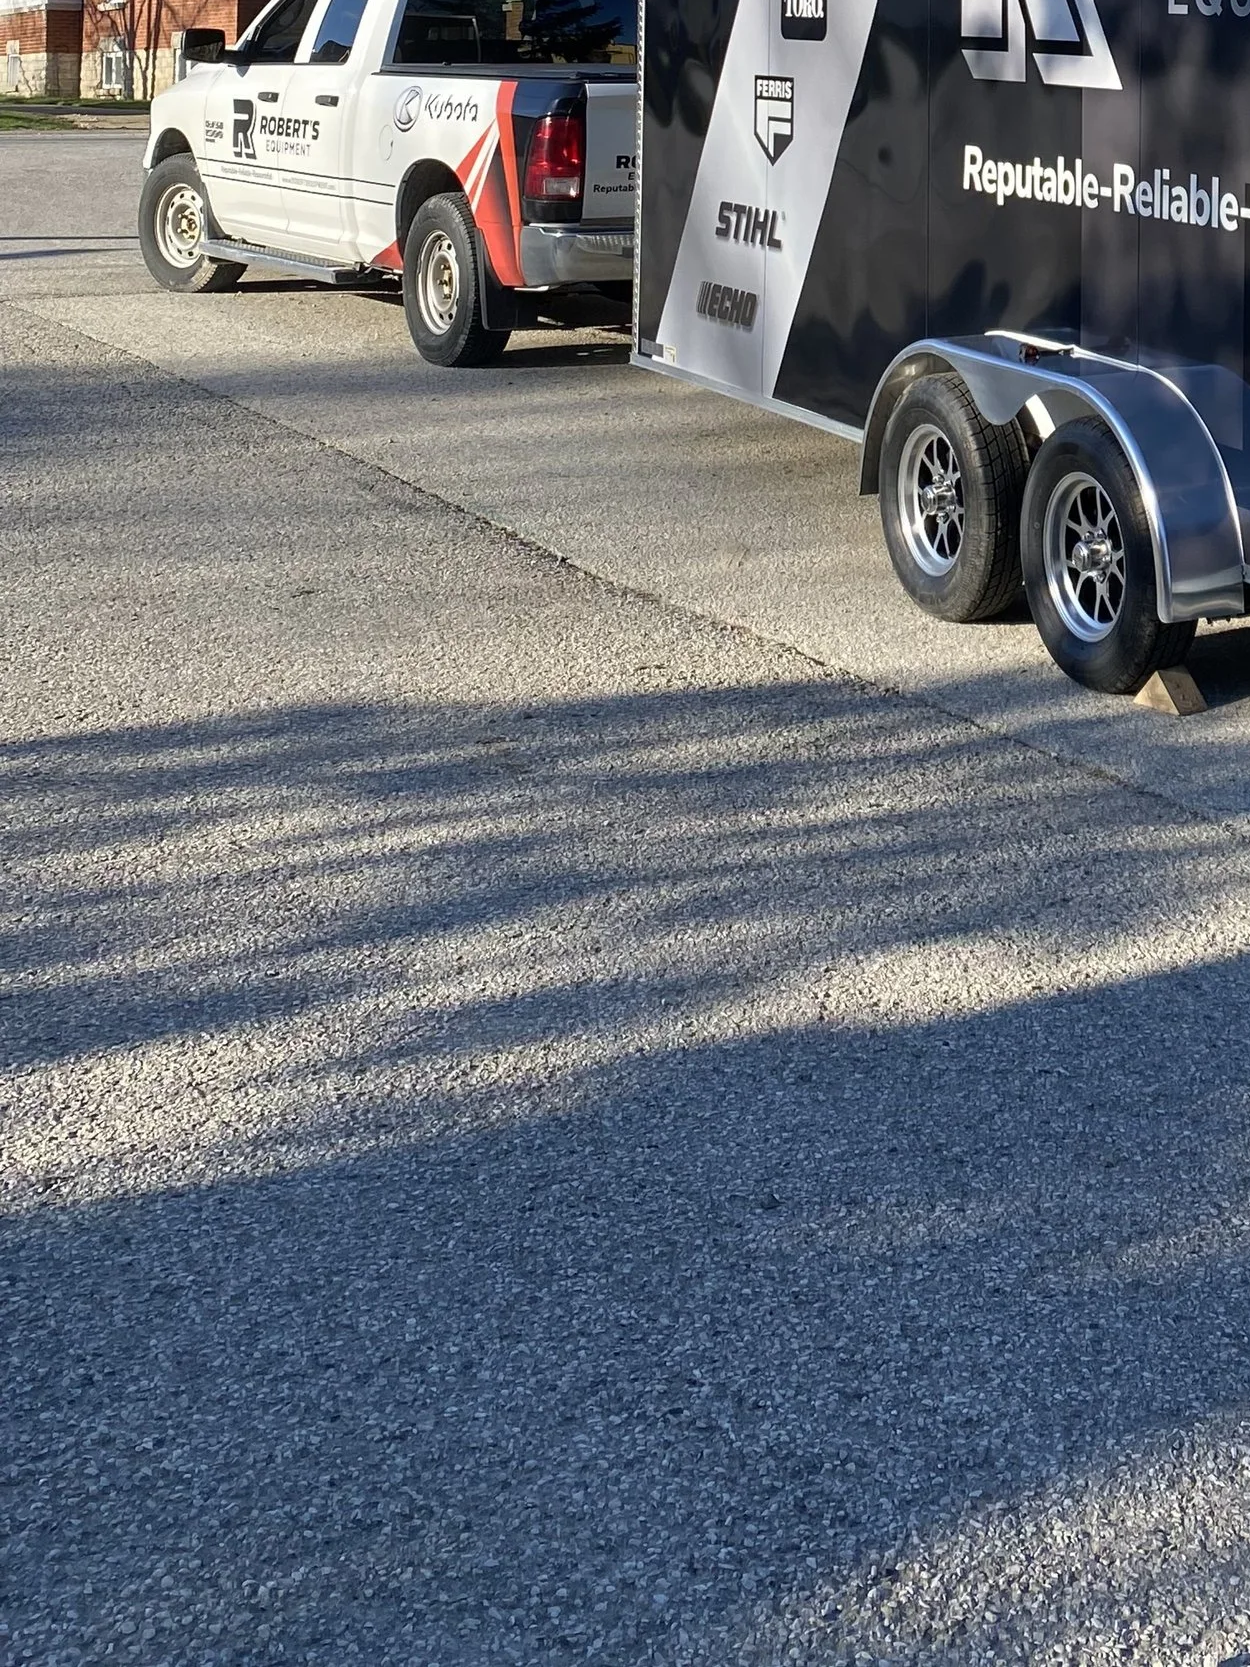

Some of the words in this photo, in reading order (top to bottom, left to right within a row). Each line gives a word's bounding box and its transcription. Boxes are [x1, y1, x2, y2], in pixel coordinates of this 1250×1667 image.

[757, 79, 792, 99] FERRIS
[425, 94, 478, 122] Kubota
[260, 115, 320, 141] ROBERT'S
[266, 139, 311, 157] EQUIPMENT
[716, 201, 782, 249] STIHL
